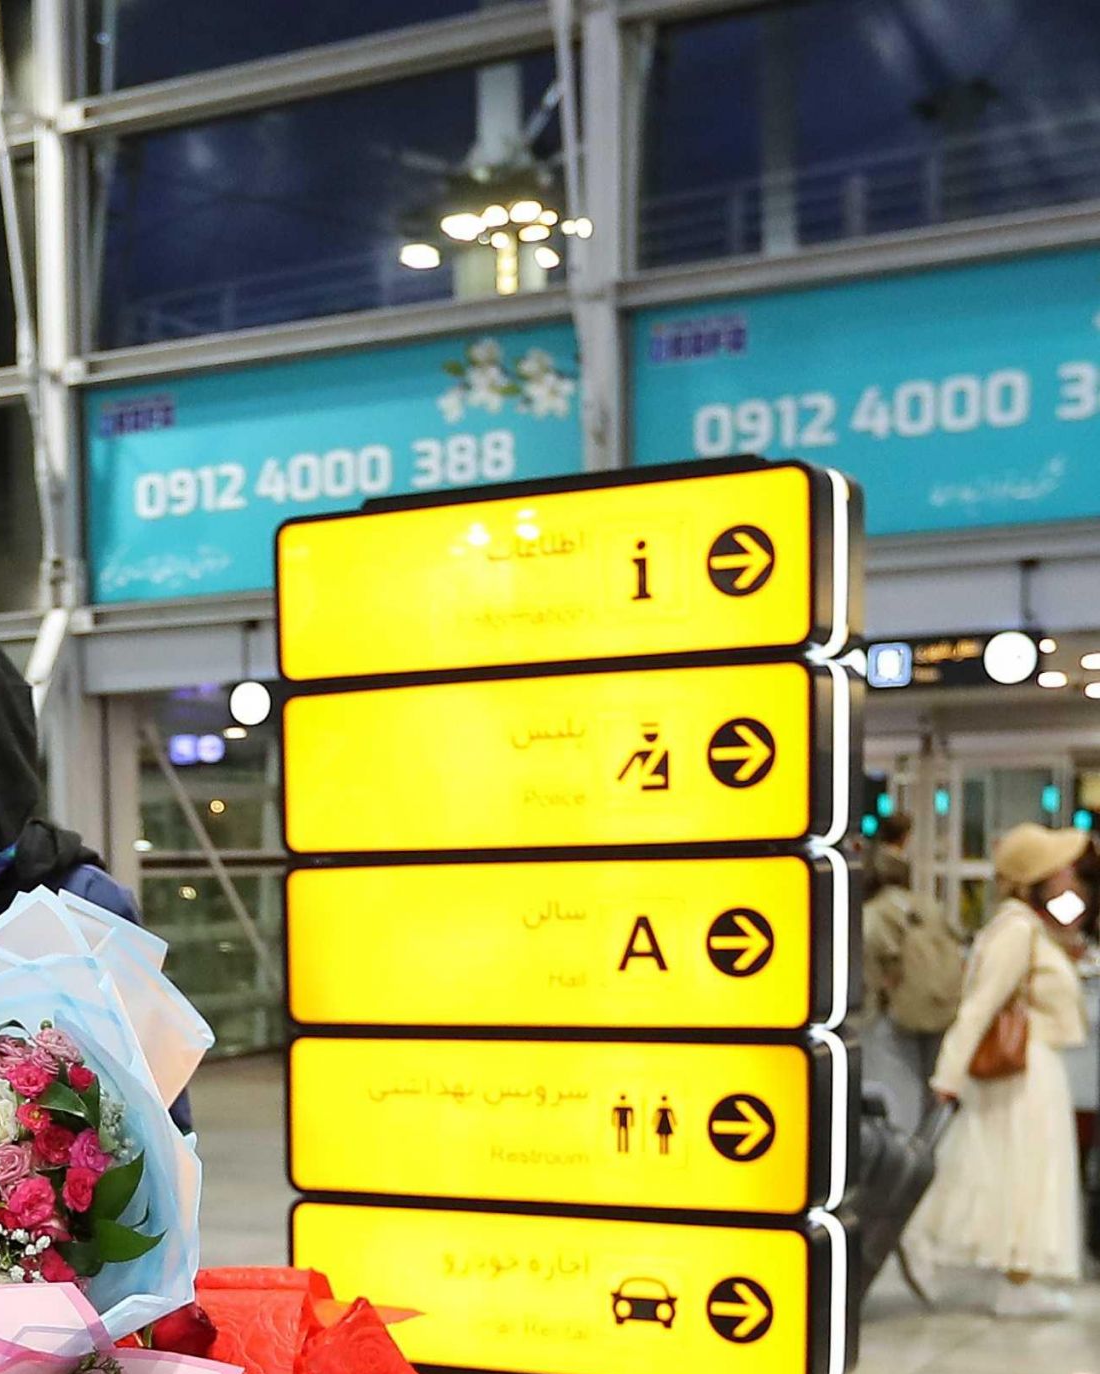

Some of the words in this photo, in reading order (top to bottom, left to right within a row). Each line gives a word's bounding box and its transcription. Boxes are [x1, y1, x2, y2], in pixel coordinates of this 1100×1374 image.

[693, 391, 838, 457] 0912
[851, 367, 1030, 439] 4000
[134, 462, 248, 520] 0912
[255, 443, 393, 503] 4000
[410, 428, 517, 489] 388
[510, 715, 587, 751] پلیس
[521, 899, 588, 931] سالن
[618, 914, 669, 972] A
[490, 1144, 590, 1166] Restroom
